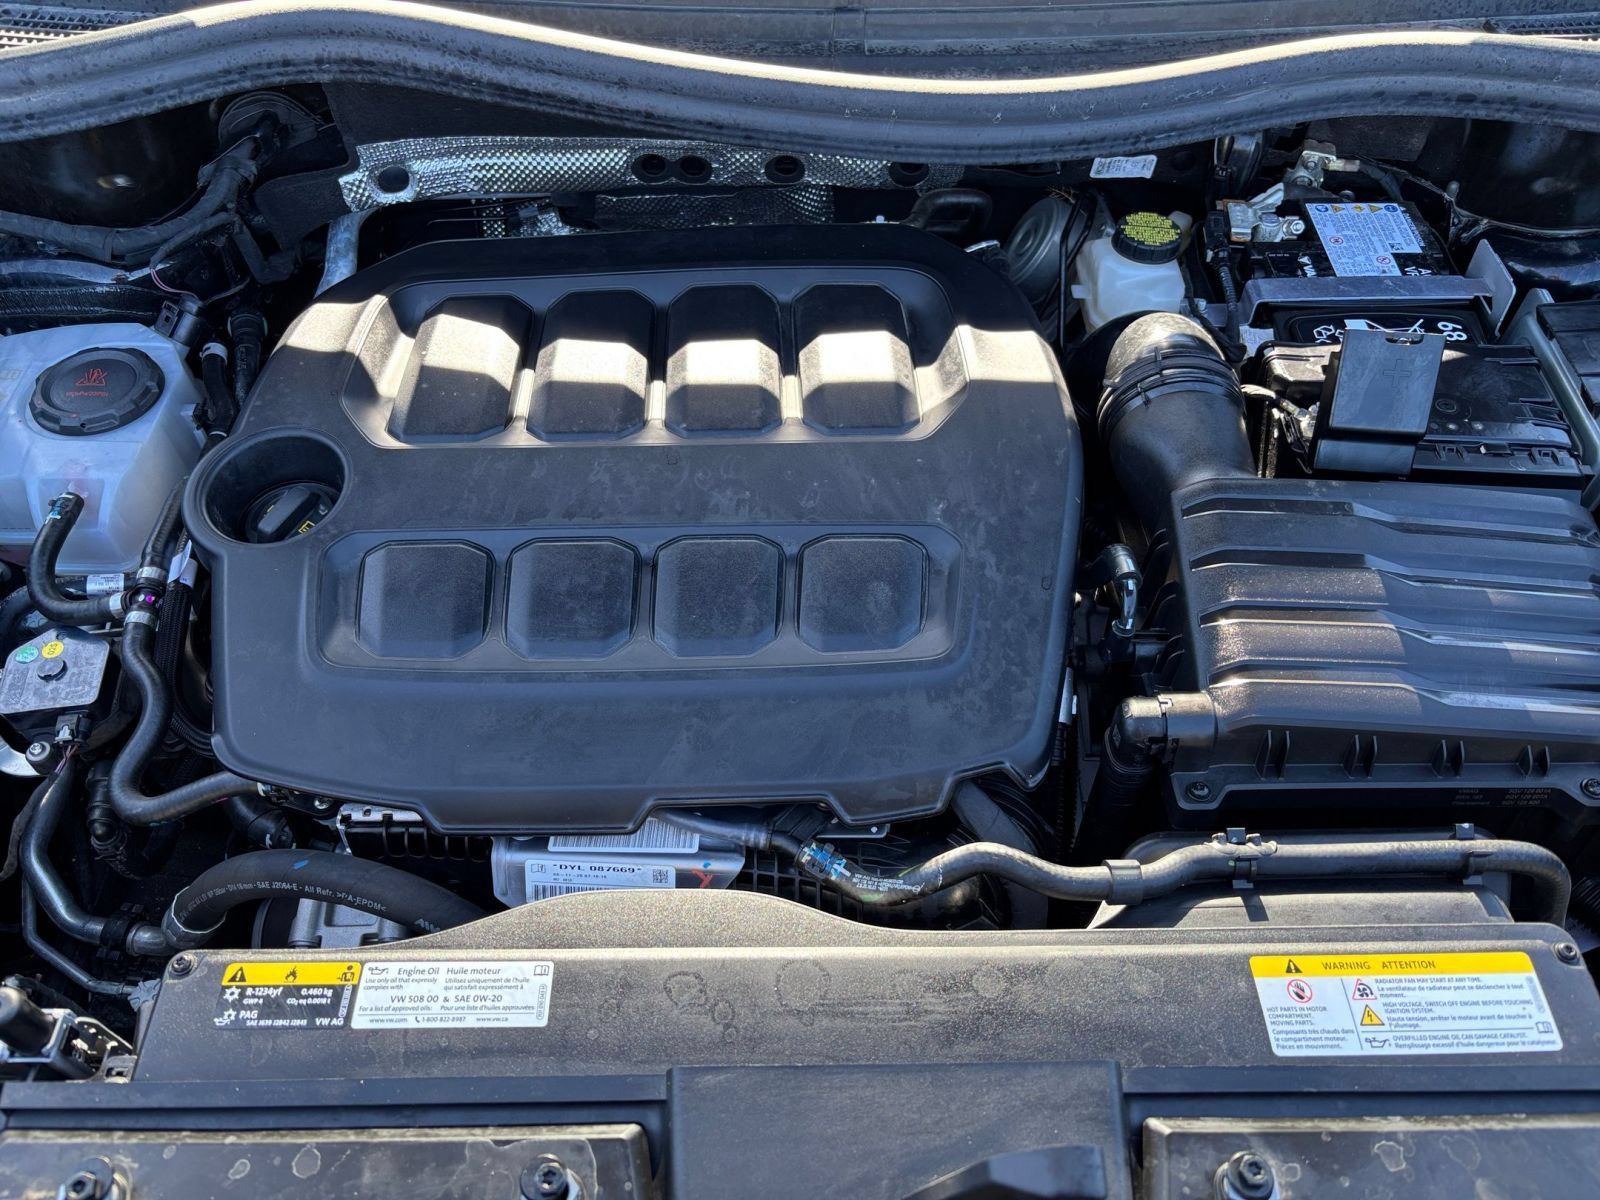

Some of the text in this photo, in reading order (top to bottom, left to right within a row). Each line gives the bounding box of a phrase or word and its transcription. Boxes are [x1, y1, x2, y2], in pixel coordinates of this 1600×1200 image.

[304, 885, 314, 894] All
[316, 887, 335, 898] Refr.
[1322, 960, 1436, 970] WARNING ATTENTION
[397, 966, 426, 977] Engine
[427, 967, 440, 975] Oil
[446, 967, 469, 975] Huile
[245, 987, 283, 998] R-1234yf
[322, 988, 333, 997] kg
[390, 995, 407, 1003] VW
[407, 995, 425, 1003] 508
[426, 995, 439, 1003] 00
[454, 995, 471, 1003] SAE
[472, 994, 503, 1003] 0W-20
[239, 1010, 259, 1020] PAG
[315, 1018, 330, 1026] VW
[330, 1018, 345, 1026] AG
[1272, 1028, 1308, 1036] Composants
